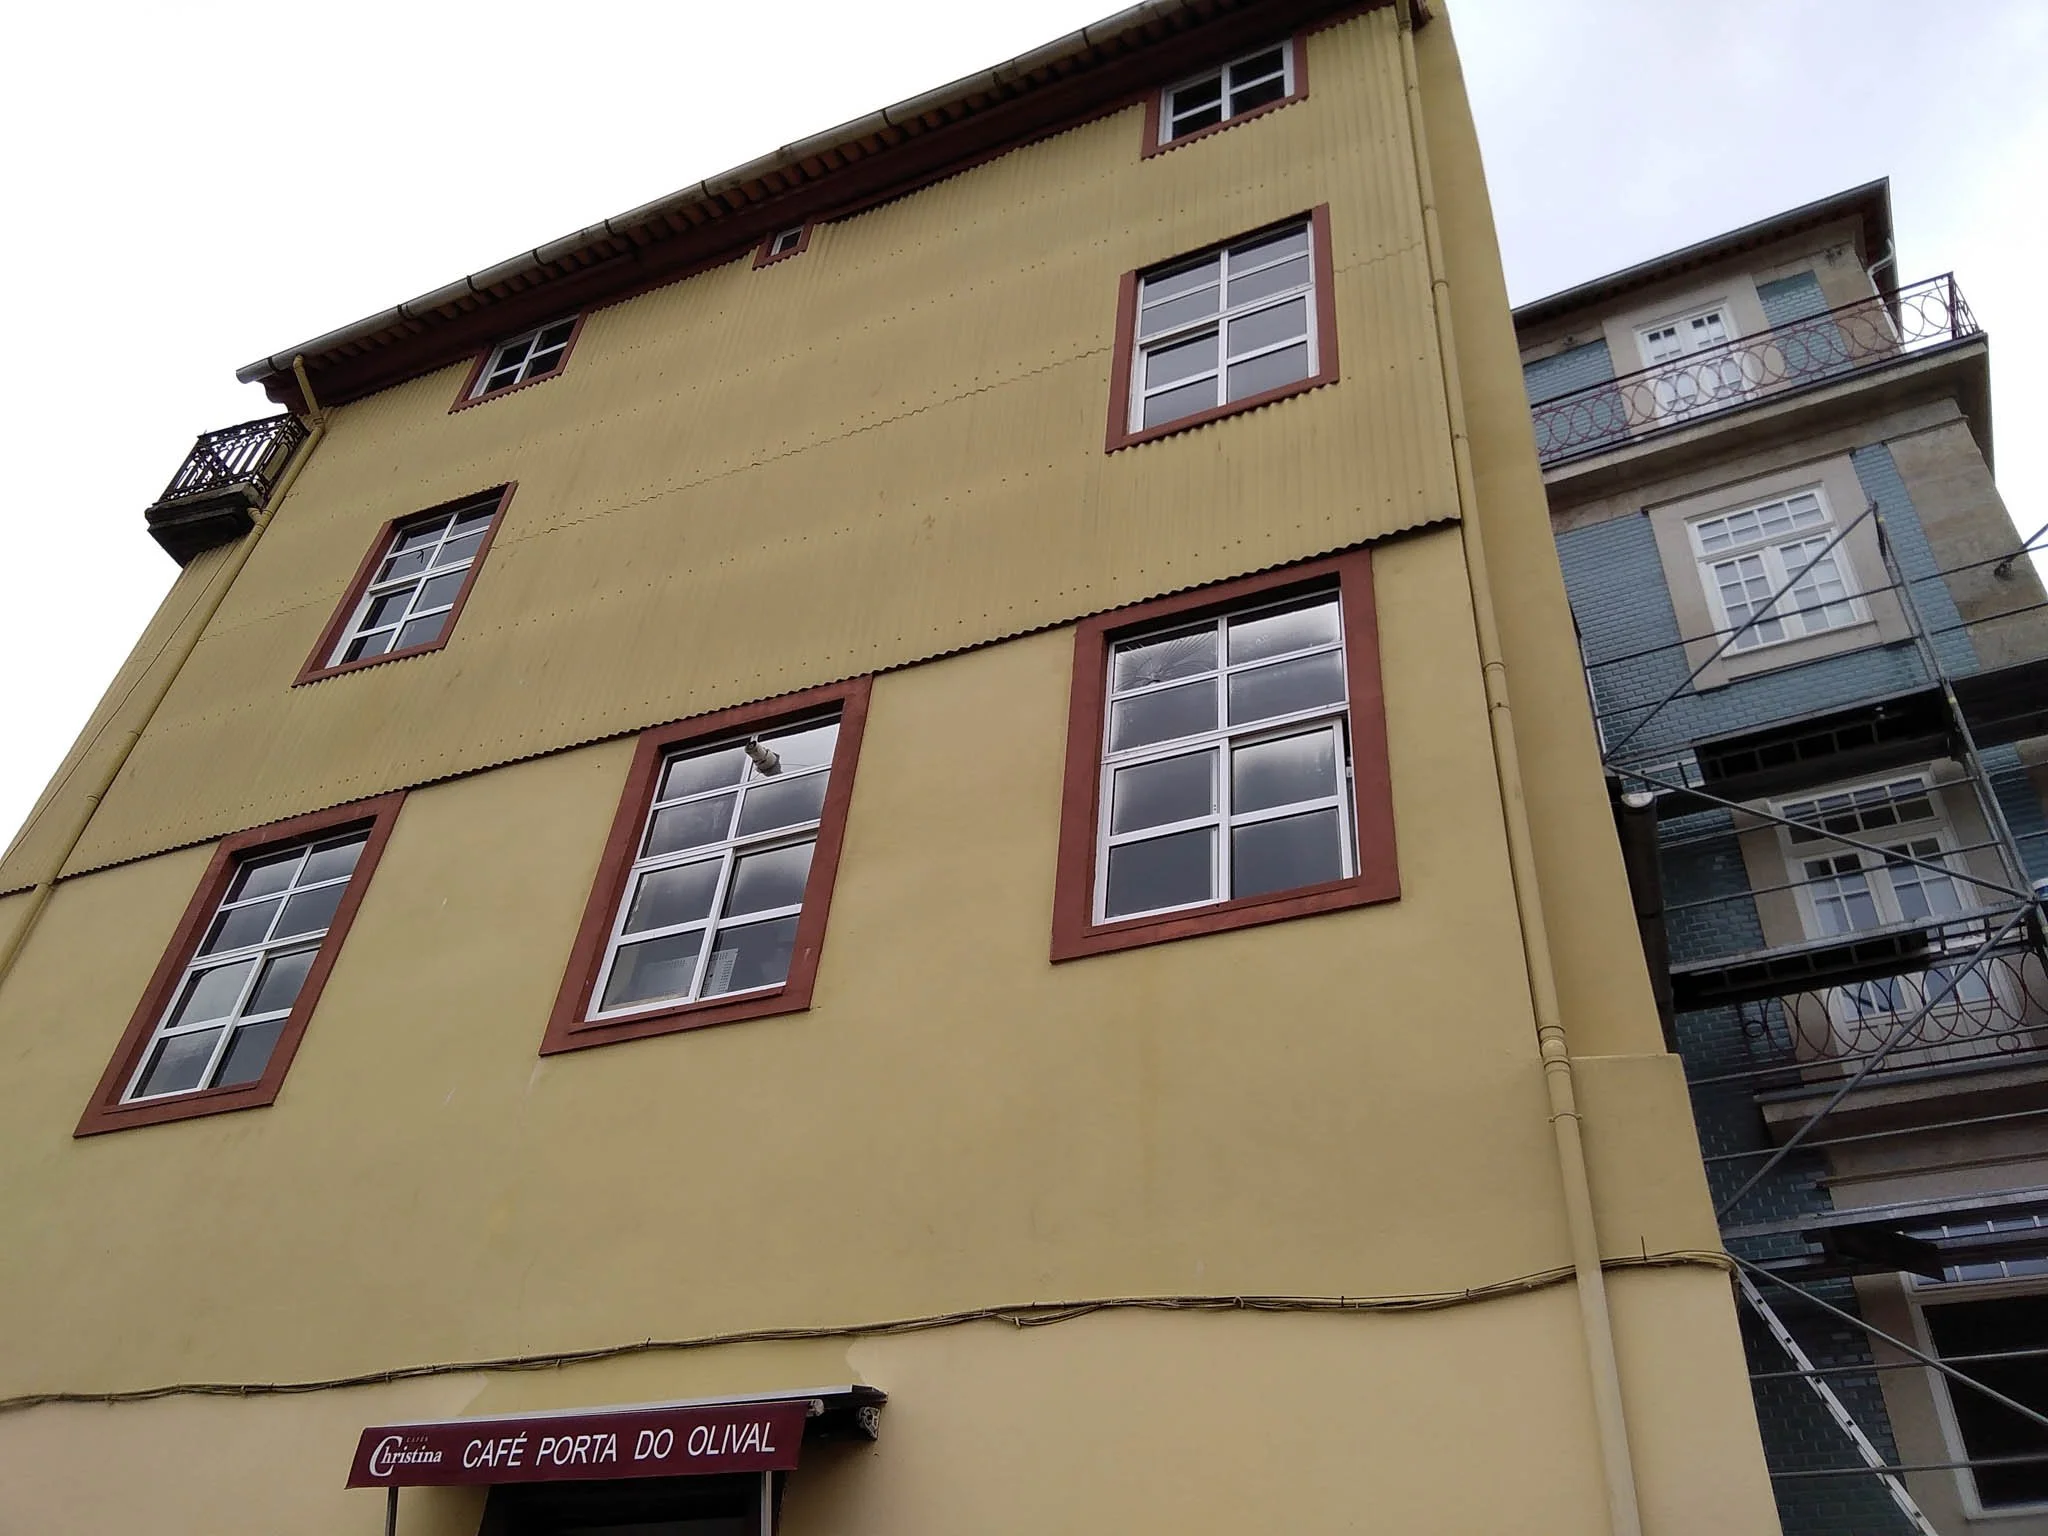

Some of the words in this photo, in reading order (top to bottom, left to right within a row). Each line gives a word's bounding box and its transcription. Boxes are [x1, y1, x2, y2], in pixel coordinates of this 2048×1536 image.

[370, 1436, 442, 1476] Christina
[463, 1432, 528, 1468] CAFÉ
[536, 1433, 617, 1466] PORTA
[634, 1429, 674, 1460] DO
[687, 1422, 776, 1456] OLIVAL
